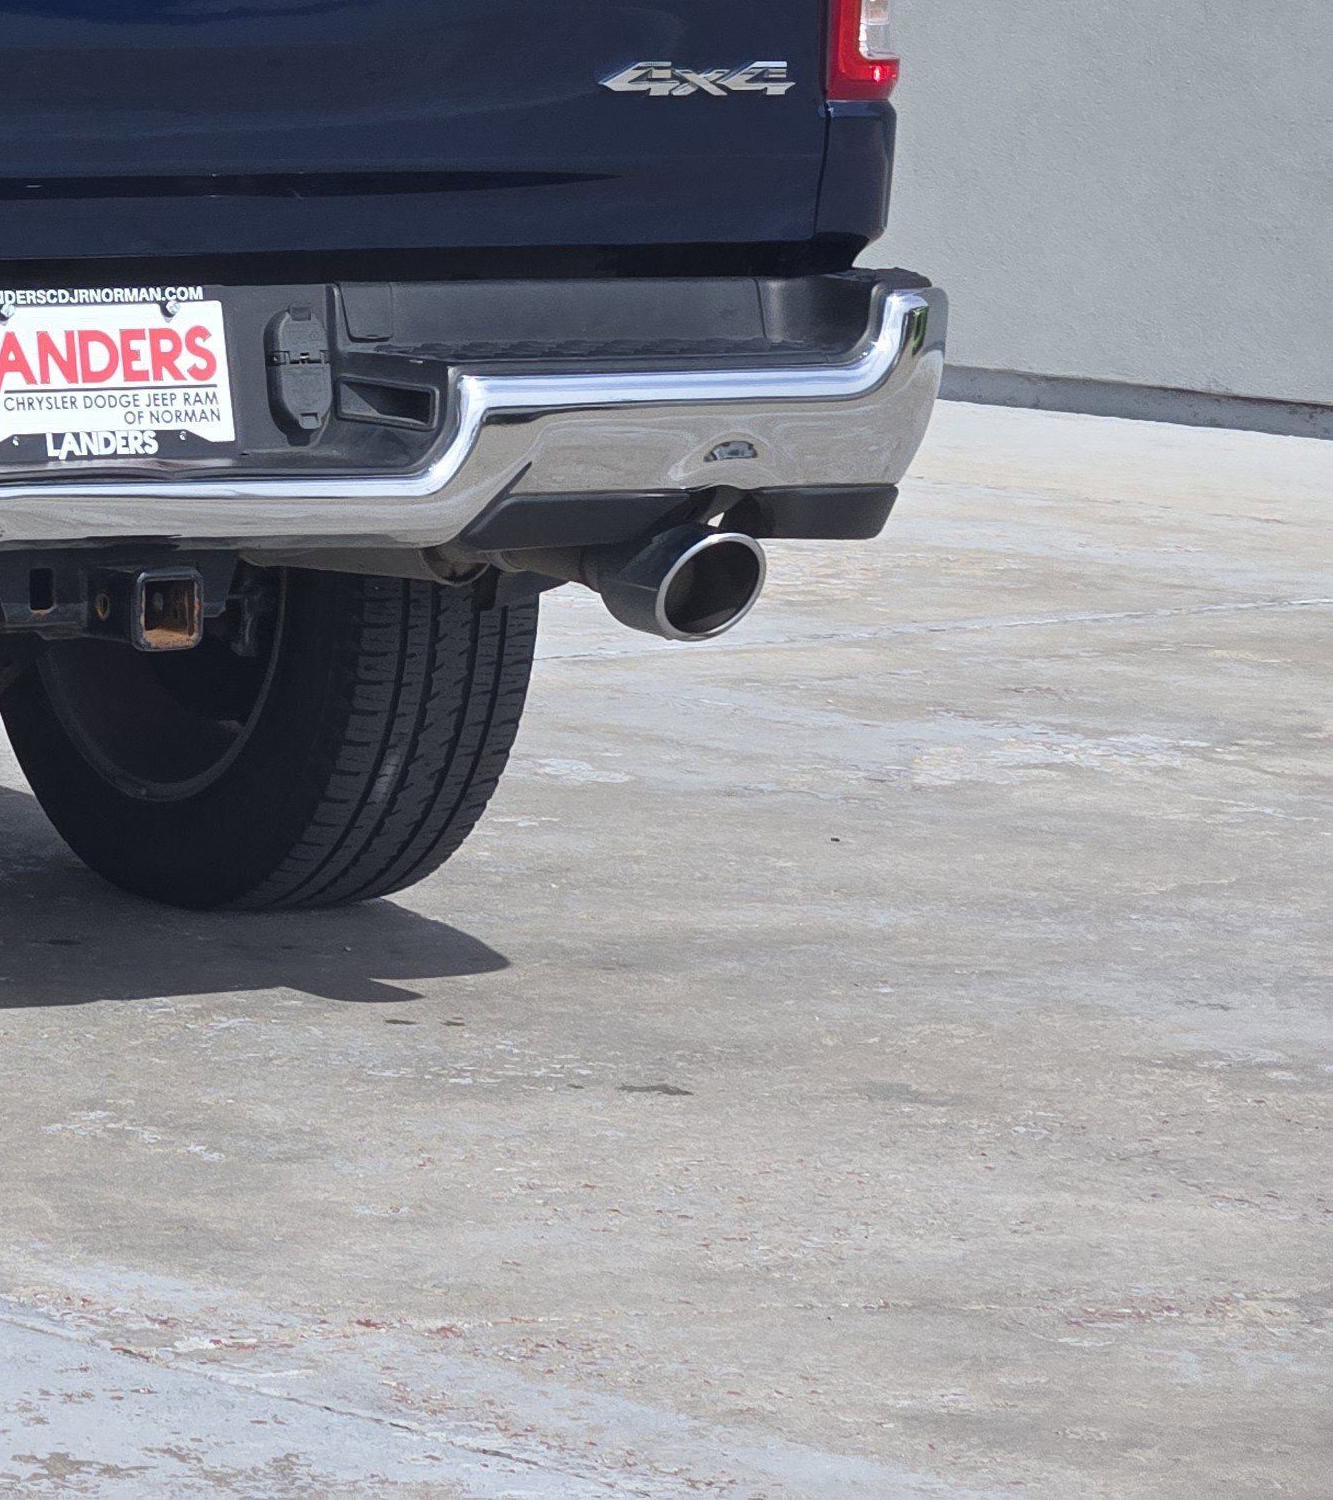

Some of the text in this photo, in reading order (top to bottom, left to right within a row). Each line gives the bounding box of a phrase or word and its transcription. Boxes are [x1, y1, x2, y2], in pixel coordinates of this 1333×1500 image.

[3, 391, 218, 411] CHRYSLER DODGE JEEP RAM
[124, 408, 221, 424] OF NORMAN
[45, 430, 159, 460] LANDERS
